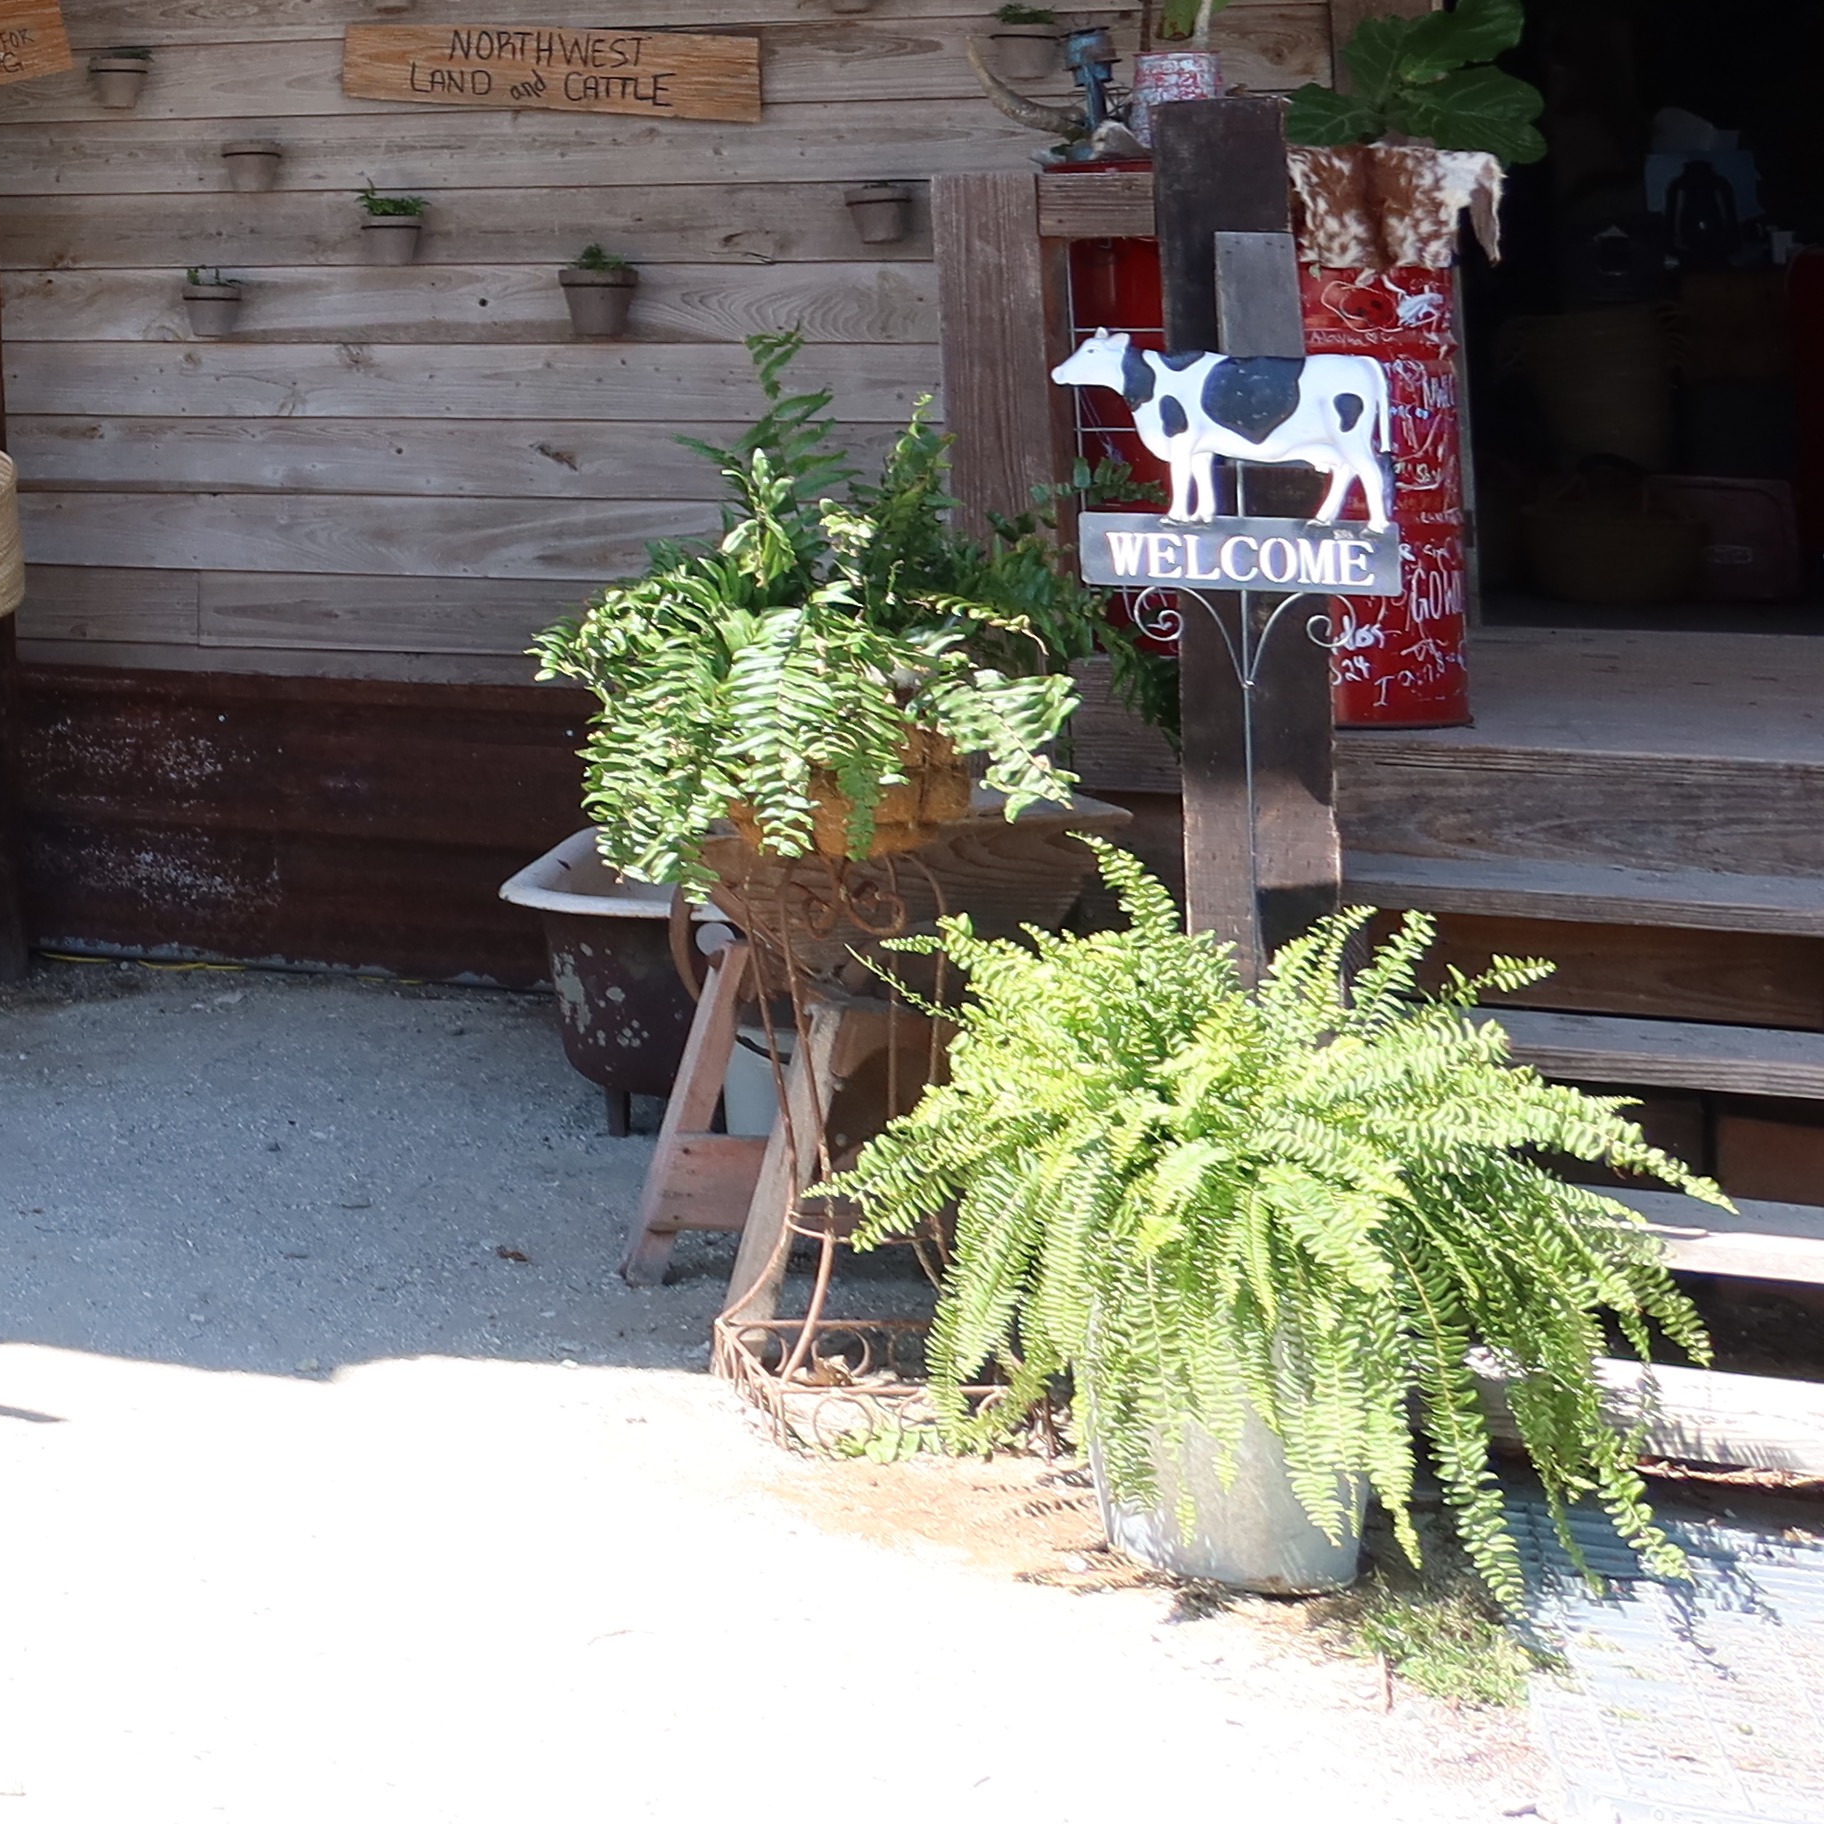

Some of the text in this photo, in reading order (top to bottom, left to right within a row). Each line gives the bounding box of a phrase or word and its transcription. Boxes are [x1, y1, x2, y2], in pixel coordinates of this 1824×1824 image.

[0, 28, 36, 52] FOR
[448, 28, 654, 68] NORTHWEST
[409, 62, 677, 108] LAND and CATTLE
[1104, 530, 1376, 587] WELCOME
